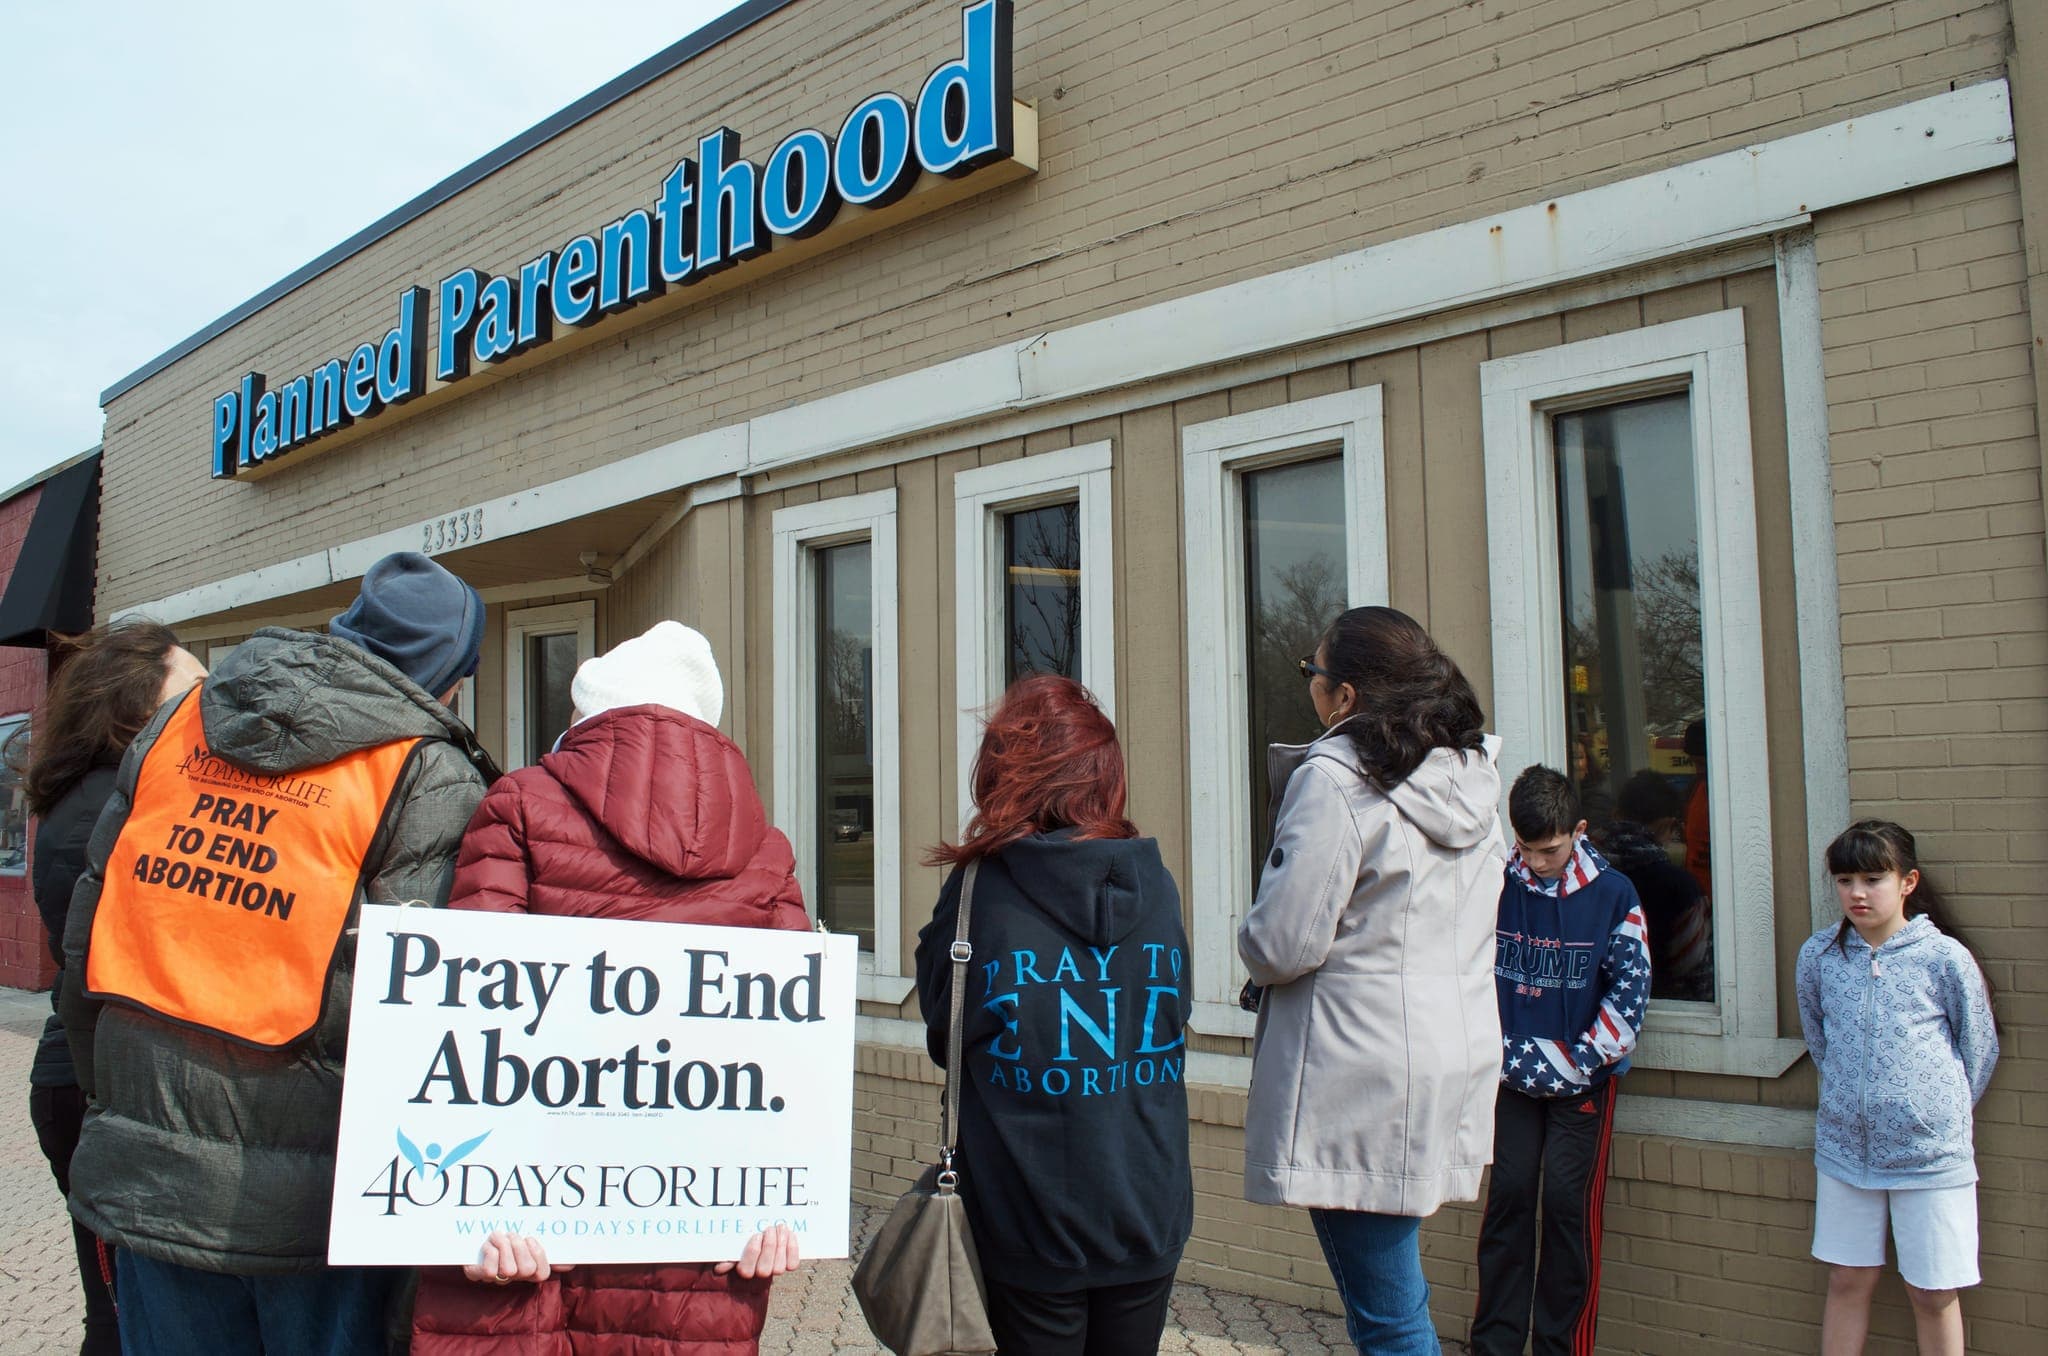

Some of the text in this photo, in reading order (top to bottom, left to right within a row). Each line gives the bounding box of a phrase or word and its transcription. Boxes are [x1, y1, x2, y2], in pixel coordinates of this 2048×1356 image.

[211, 0, 1005, 481] Planned Parenthood
[422, 508, 483, 553] 23338
[189, 792, 279, 835] PRAY
[275, 793, 310, 810] ABORTION
[284, 776, 332, 808] LIFE
[165, 824, 278, 874] TO END
[132, 853, 296, 921] ABORTION
[379, 931, 825, 1036] Pray to End
[982, 943, 1182, 997] PRAY TO
[1496, 937, 1592, 979] RUMP
[982, 985, 1185, 1062] END
[407, 1028, 785, 1113] Abortion.
[988, 1056, 1183, 1097] ABORTION
[361, 1154, 450, 1216] 40
[454, 1164, 586, 1208] DAYS
[596, 1165, 705, 1208] FOR
[705, 1166, 809, 1207] LIFE
